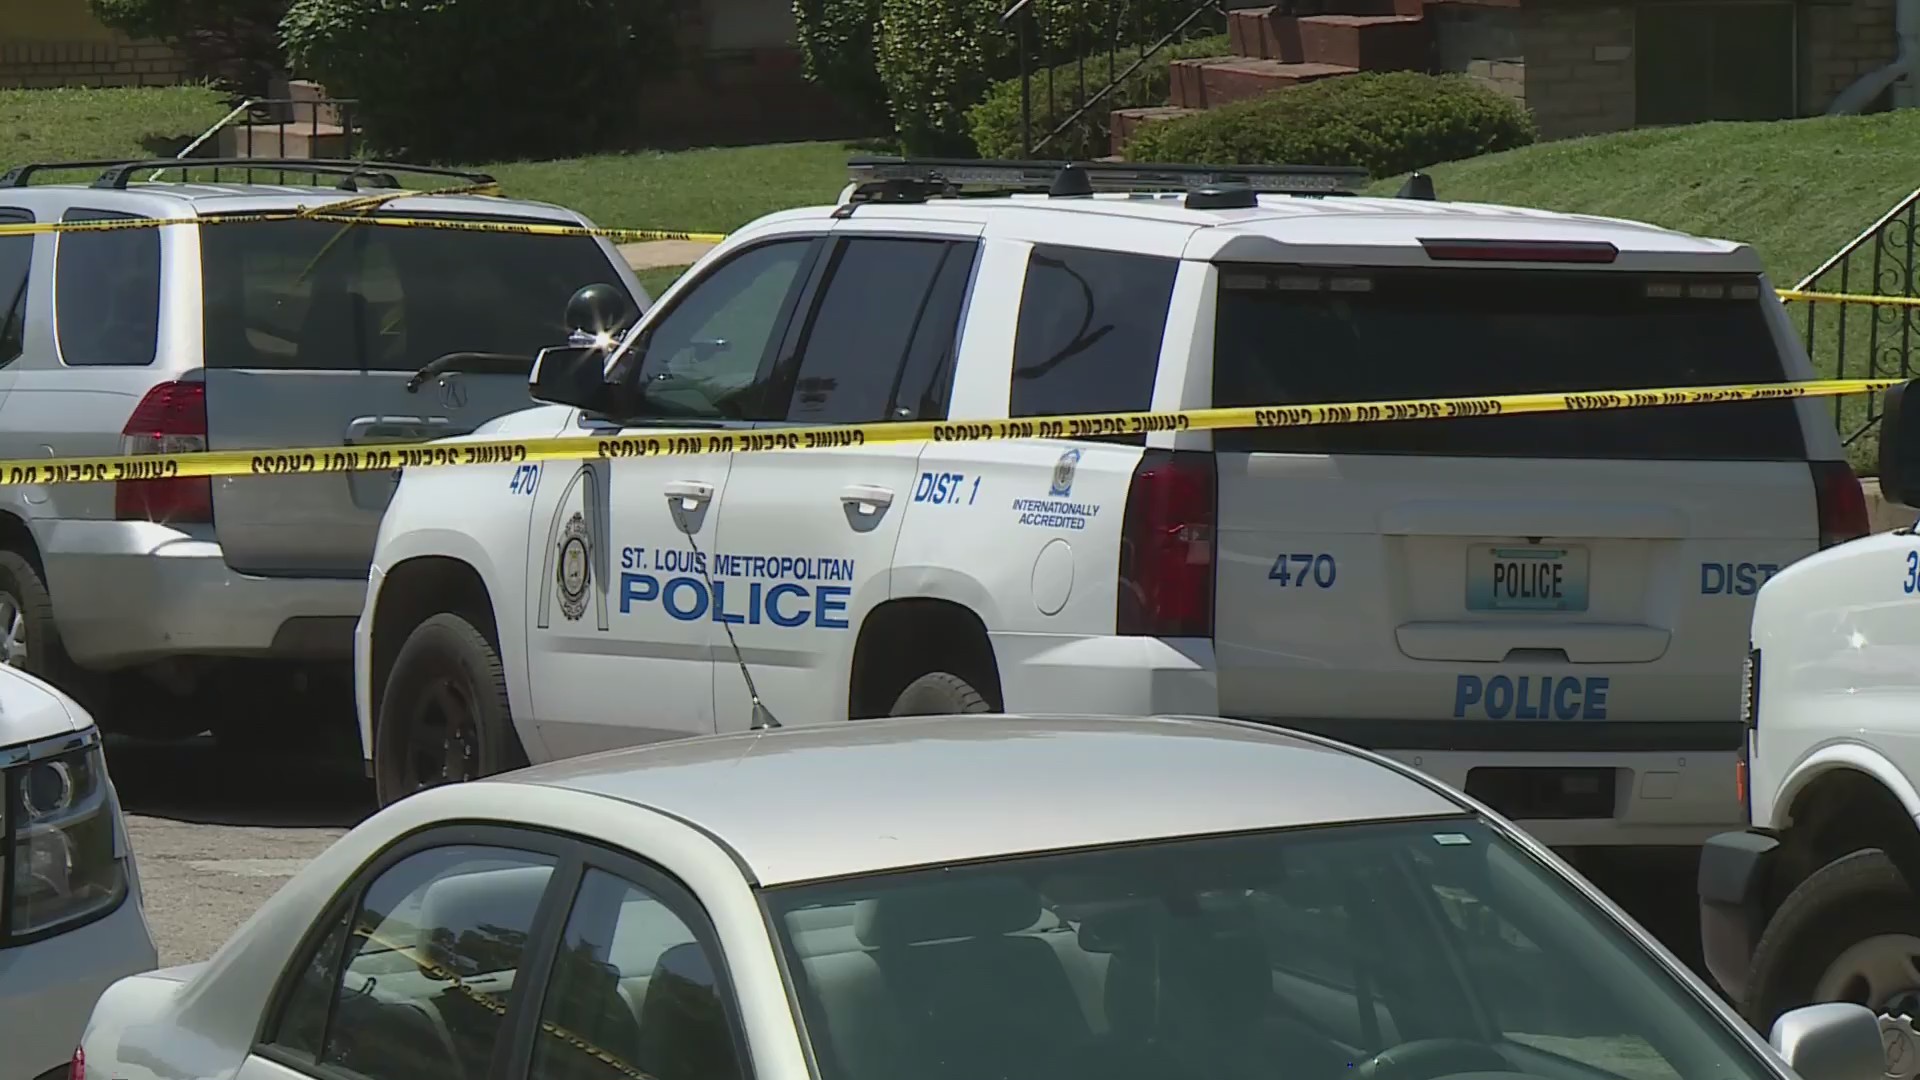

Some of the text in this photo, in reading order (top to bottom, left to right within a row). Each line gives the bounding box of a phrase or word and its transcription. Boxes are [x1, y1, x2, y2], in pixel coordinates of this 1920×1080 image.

[510, 464, 538, 495] 470
[914, 472, 981, 505] DIST. 1
[1012, 499, 1100, 517] INTERNATIONALLY
[1019, 513, 1085, 530] ACCREDITED
[621, 547, 854, 581] ST. LOUIS METROPOLITAN
[1268, 553, 1336, 588] 470
[1494, 562, 1563, 599] POLICE
[1904, 550, 1920, 594] 3
[620, 572, 851, 629] POLICE
[1453, 674, 1609, 720] POLICE
